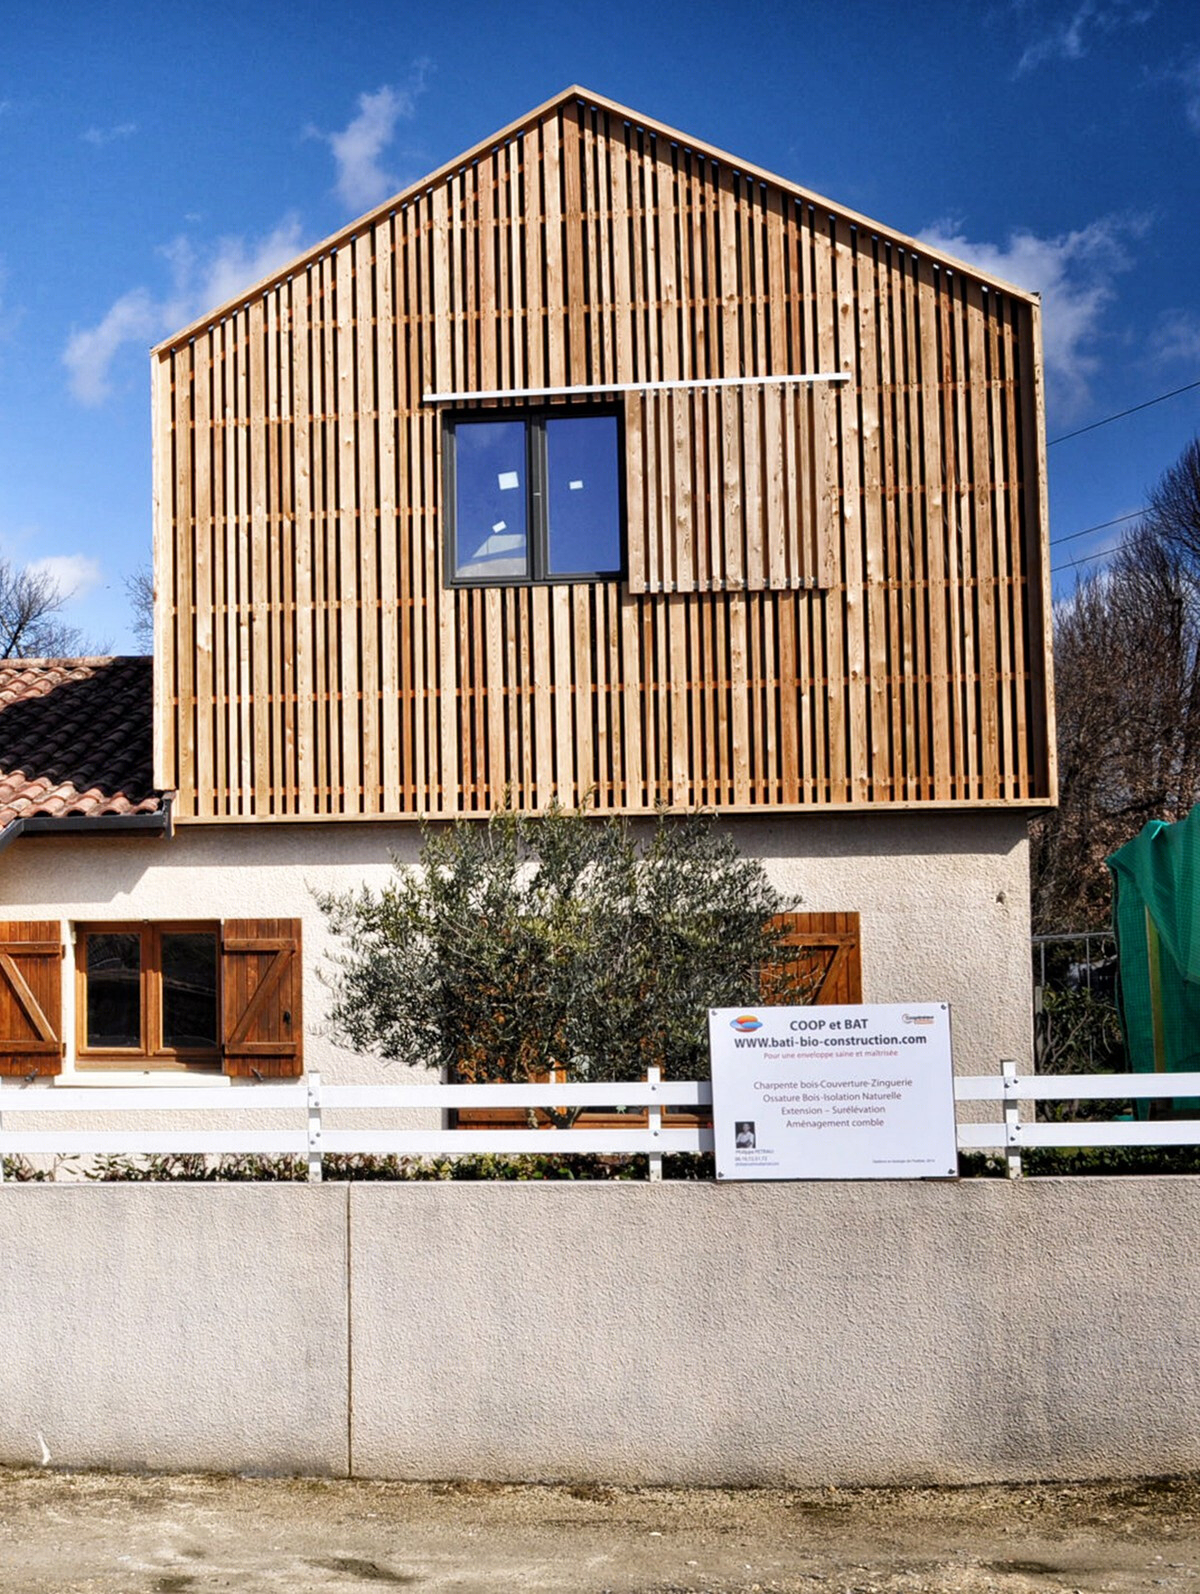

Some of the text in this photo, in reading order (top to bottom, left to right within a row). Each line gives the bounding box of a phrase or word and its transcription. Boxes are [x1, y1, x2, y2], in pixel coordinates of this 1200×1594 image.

[790, 1018, 868, 1031] COOP et BAT
[734, 1034, 927, 1048] WWW.bati-bio-construction.com
[797, 1051, 834, 1060] enveloppe
[754, 1081, 798, 1090] Charpente
[762, 1094, 800, 1102] Ossature
[862, 1092, 902, 1100] Naturelle
[781, 1106, 823, 1116] Extension
[832, 1105, 886, 1114] Surélévation
[786, 1118, 884, 1130] Aménagement comble
